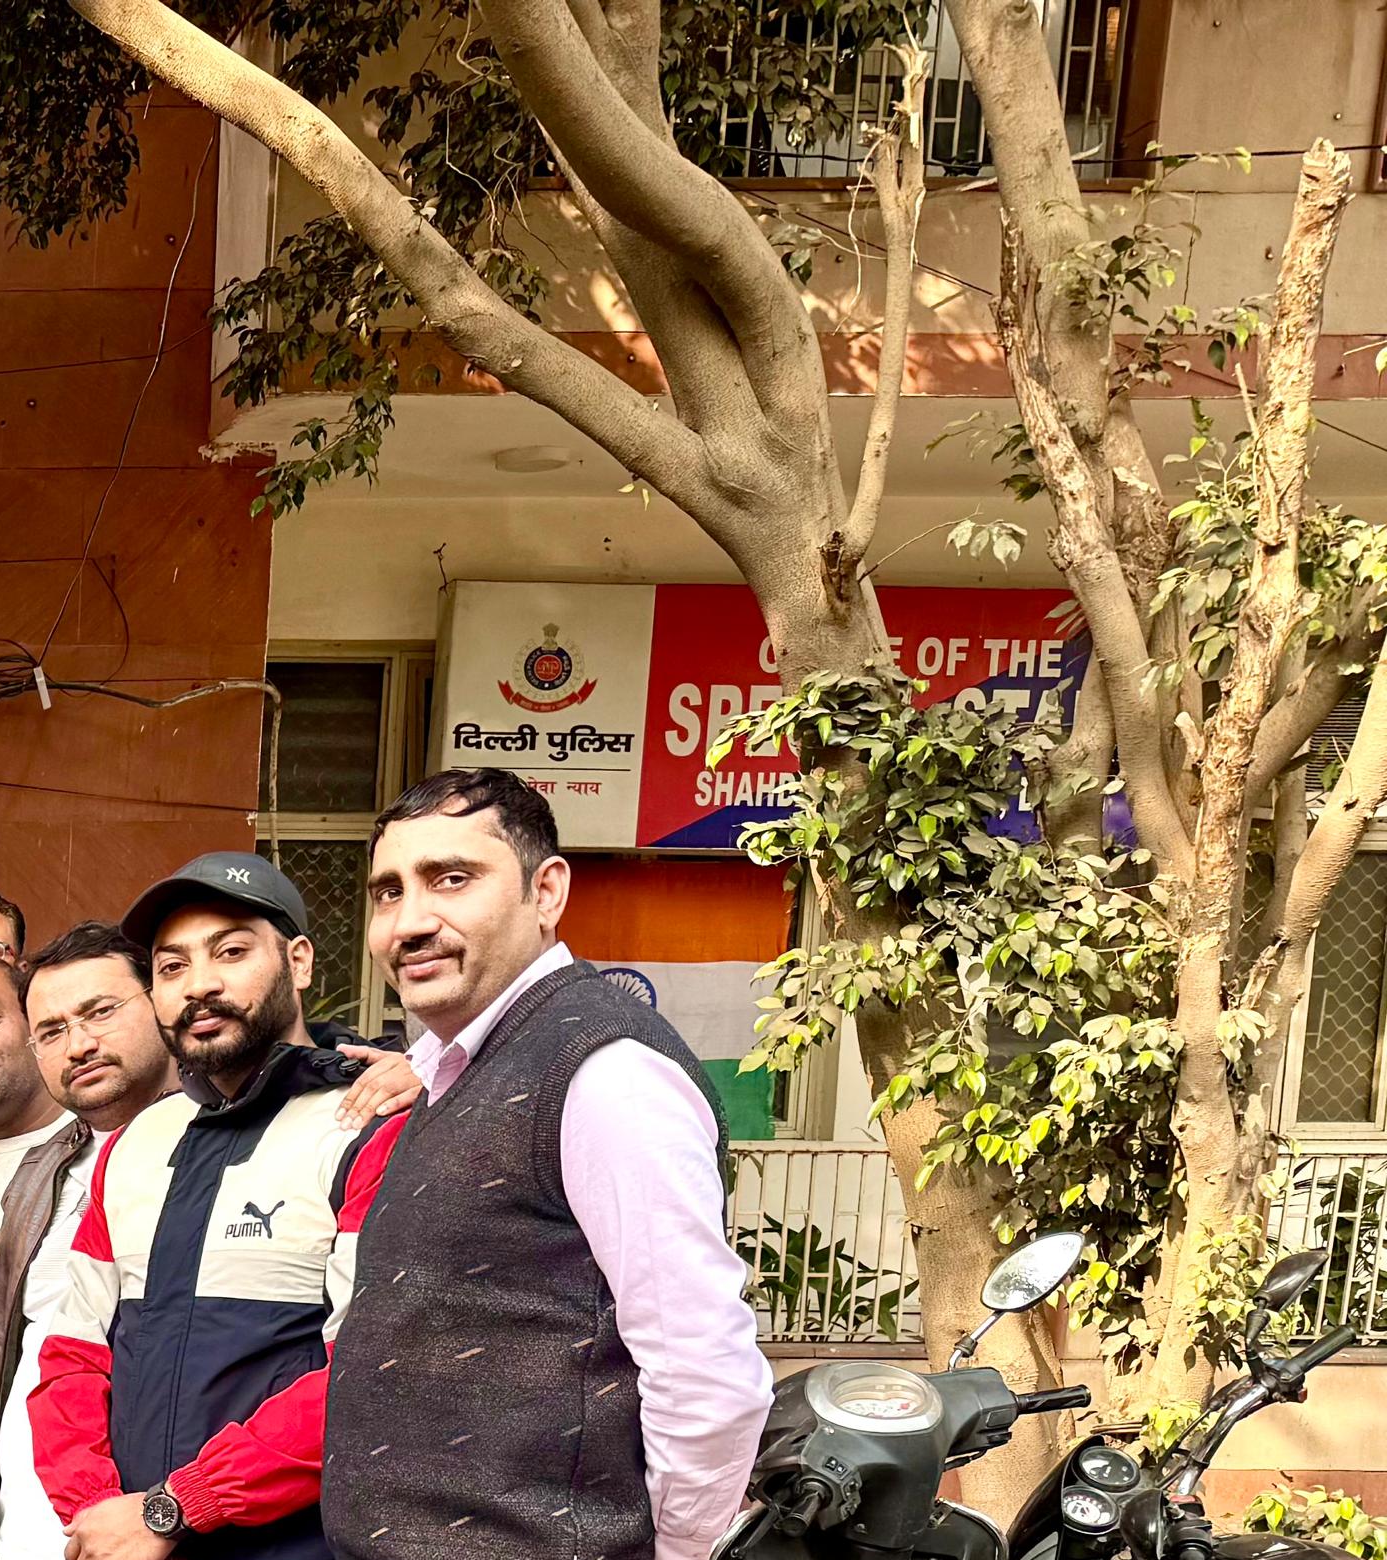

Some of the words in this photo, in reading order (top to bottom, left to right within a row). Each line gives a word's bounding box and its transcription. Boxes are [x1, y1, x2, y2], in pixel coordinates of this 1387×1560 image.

[916, 637, 970, 676] OF
[983, 638, 1064, 678] THE
[452, 722, 539, 751] दिल्ली
[546, 724, 635, 762] पुलिस
[566, 781, 602, 796] न्याय
[225, 1222, 263, 1239] PUMA
